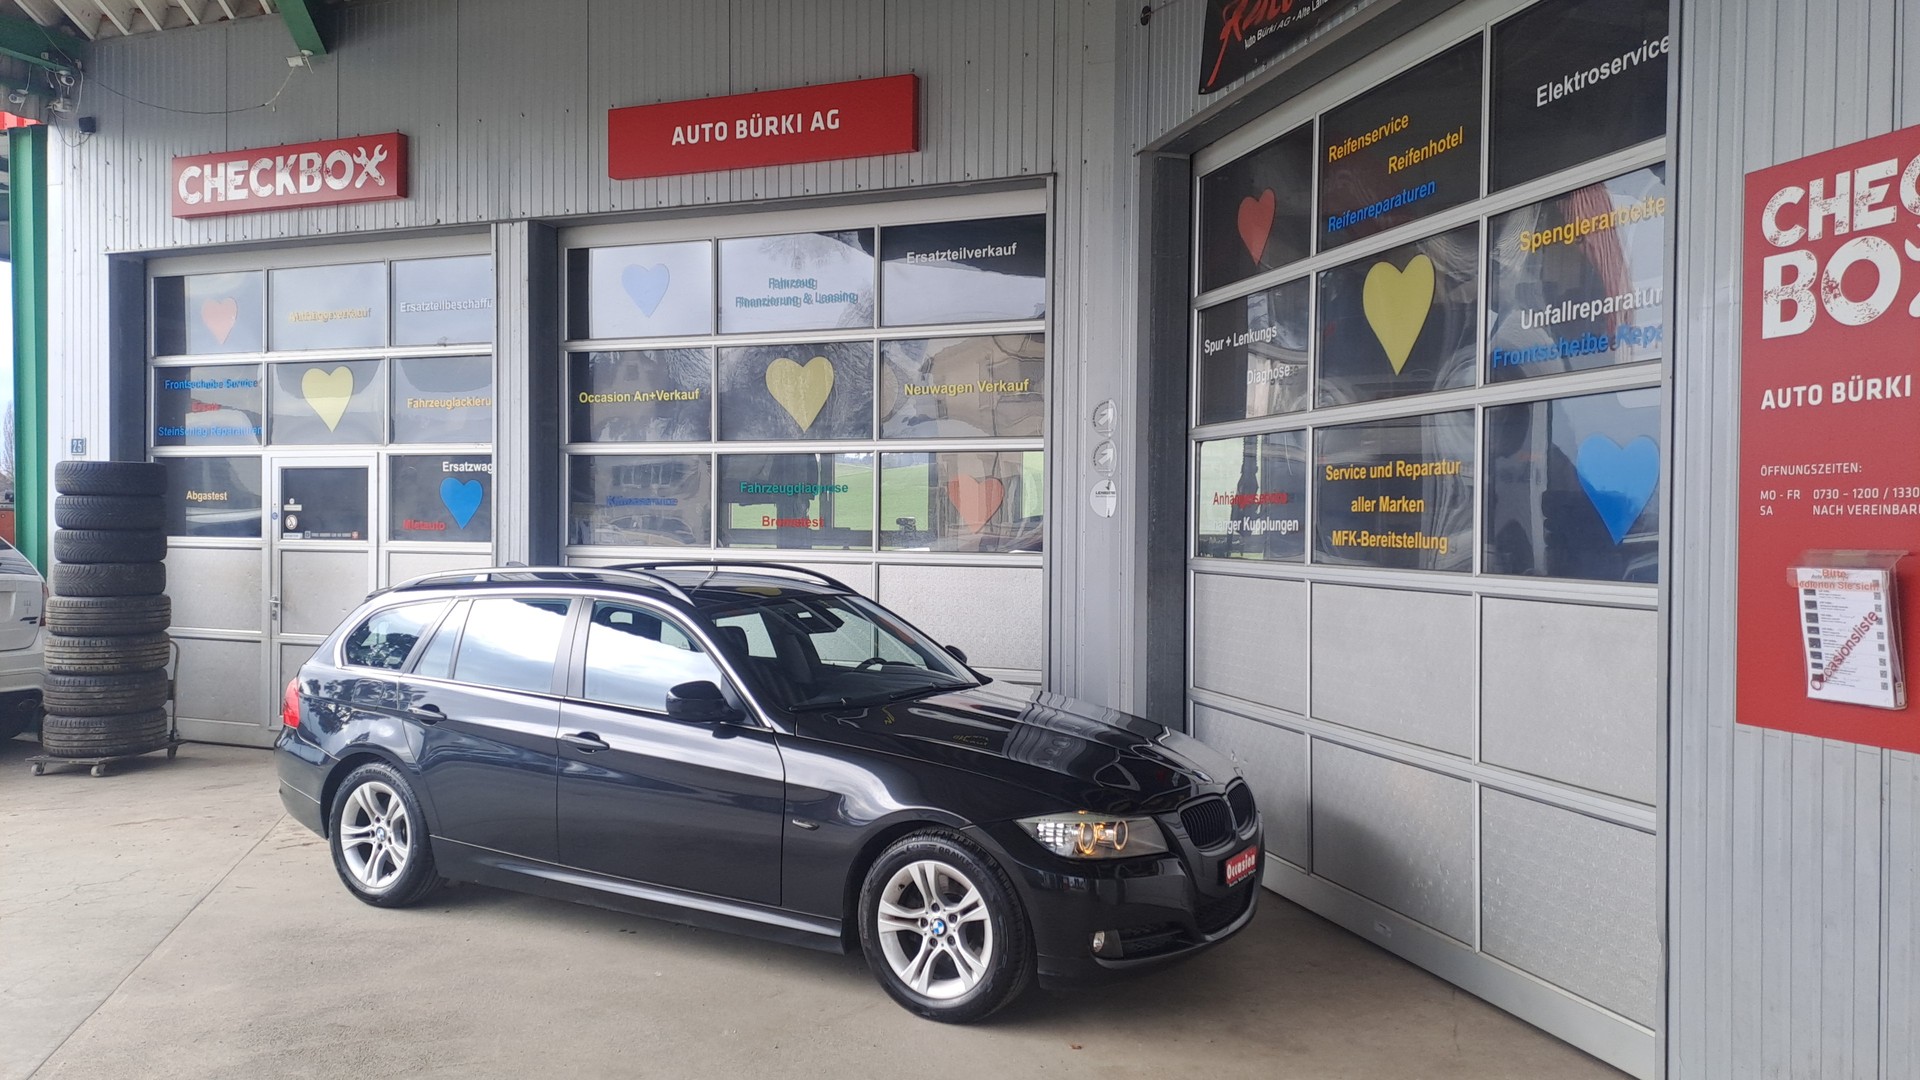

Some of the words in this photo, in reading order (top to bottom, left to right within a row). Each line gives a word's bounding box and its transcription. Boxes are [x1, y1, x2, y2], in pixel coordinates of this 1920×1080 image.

[1277, 16, 1291, 30] AG
[1536, 35, 1669, 107] Elektroservice
[671, 121, 728, 146] AUTO
[735, 113, 802, 139] BÜRKI
[810, 108, 840, 131] AG
[1328, 114, 1409, 162] Reifenservice
[1388, 126, 1464, 174] Reifenhotel
[178, 144, 388, 205] CHECKBOX
[1327, 180, 1436, 232] Reifenreparaturen
[906, 243, 1018, 265] Ersatzteilverkauf
[1761, 224, 1920, 339] BO
[1520, 288, 1663, 330] Unfallreparatur
[1204, 340, 1225, 355] Spur
[1233, 325, 1278, 347] Lenkungs
[1493, 330, 1609, 369] Frontscheibe
[1247, 364, 1290, 386] Diagnose
[579, 393, 631, 404] Occasion
[633, 388, 700, 402] An+Verkauf
[904, 383, 974, 397] Neuwagen
[978, 378, 1029, 394] Verkauf
[1760, 384, 1823, 410] AUTO
[1831, 375, 1911, 404] BÜRKI
[1326, 463, 1367, 481] Service
[1370, 460, 1393, 478] und
[1396, 460, 1461, 481] Reparatur
[1760, 463, 1862, 477] ÖFFNUNGSZEITEN:
[186, 490, 227, 502] Abgastest
[740, 482, 849, 496] Fahrzeugdiagnose
[1760, 490, 1776, 500] MO
[1787, 490, 1801, 500] FR
[1813, 489, 1839, 500] 0730
[1852, 488, 1879, 499] 1200
[1892, 486, 1920, 498] 1330
[1351, 497, 1376, 513] aller
[1379, 496, 1425, 512] Marken
[1760, 505, 1773, 516] SA
[1812, 505, 1843, 515] NACH
[1847, 503, 1920, 515] VEREINBAR
[1243, 516, 1299, 535] Kupplungen
[1332, 530, 1448, 554] MFK-Bereitstellung
